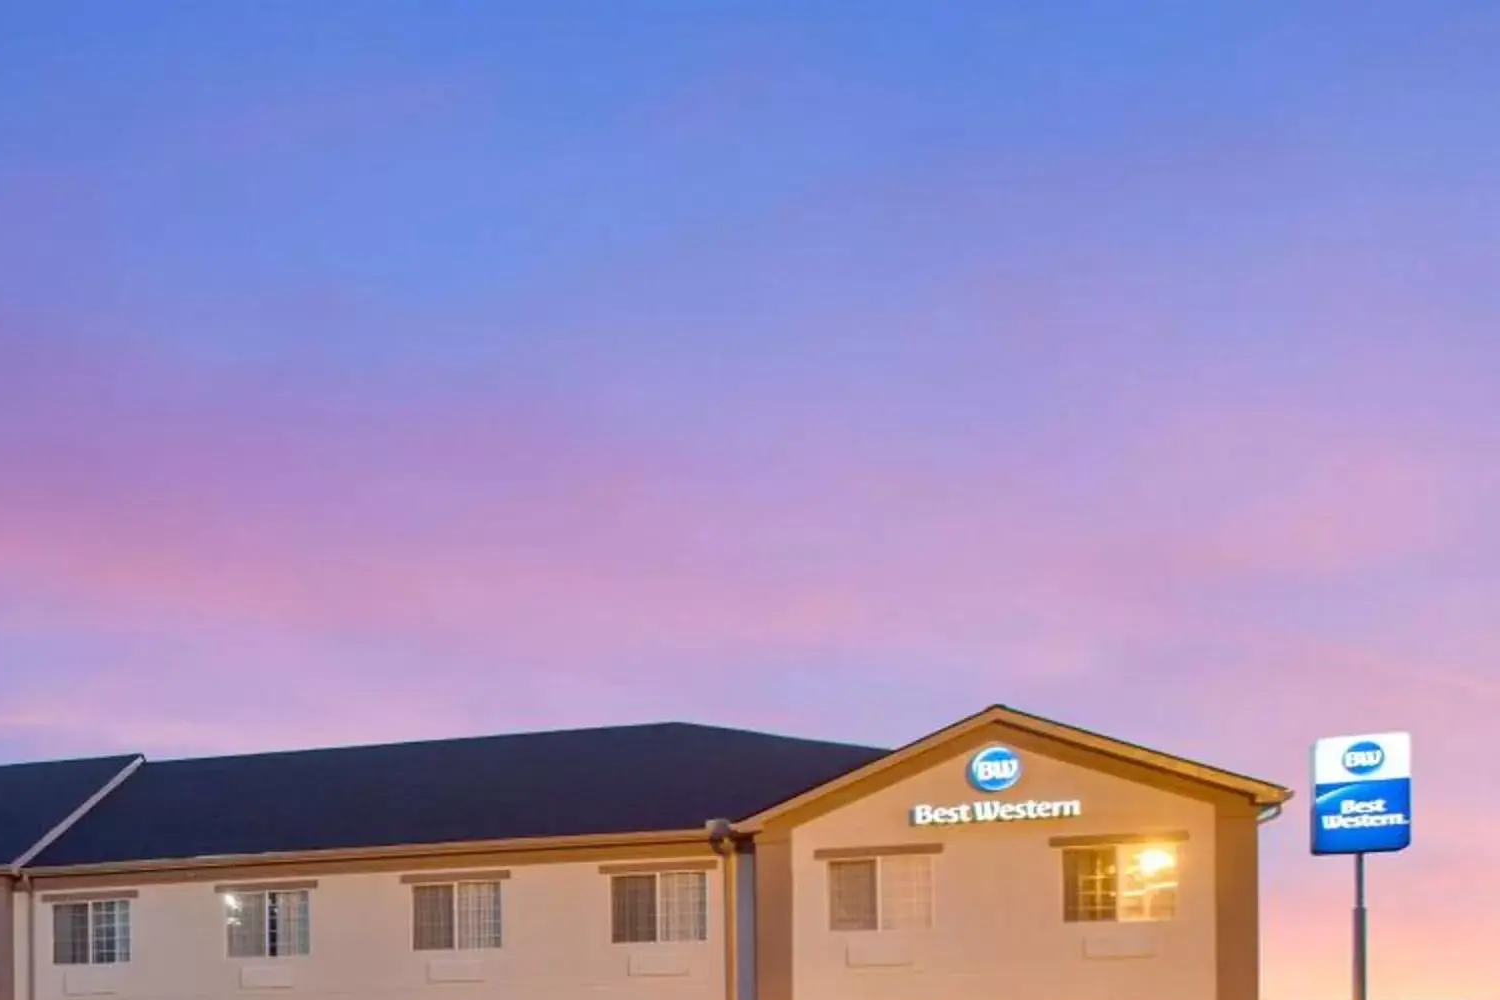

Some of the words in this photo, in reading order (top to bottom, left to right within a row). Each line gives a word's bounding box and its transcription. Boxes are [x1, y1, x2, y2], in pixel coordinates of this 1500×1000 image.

[978, 758, 1018, 780] BW
[913, 804, 971, 825] Best
[974, 799, 1081, 821] Western
[1341, 799, 1386, 814] Best
[1322, 814, 1406, 829] Western
